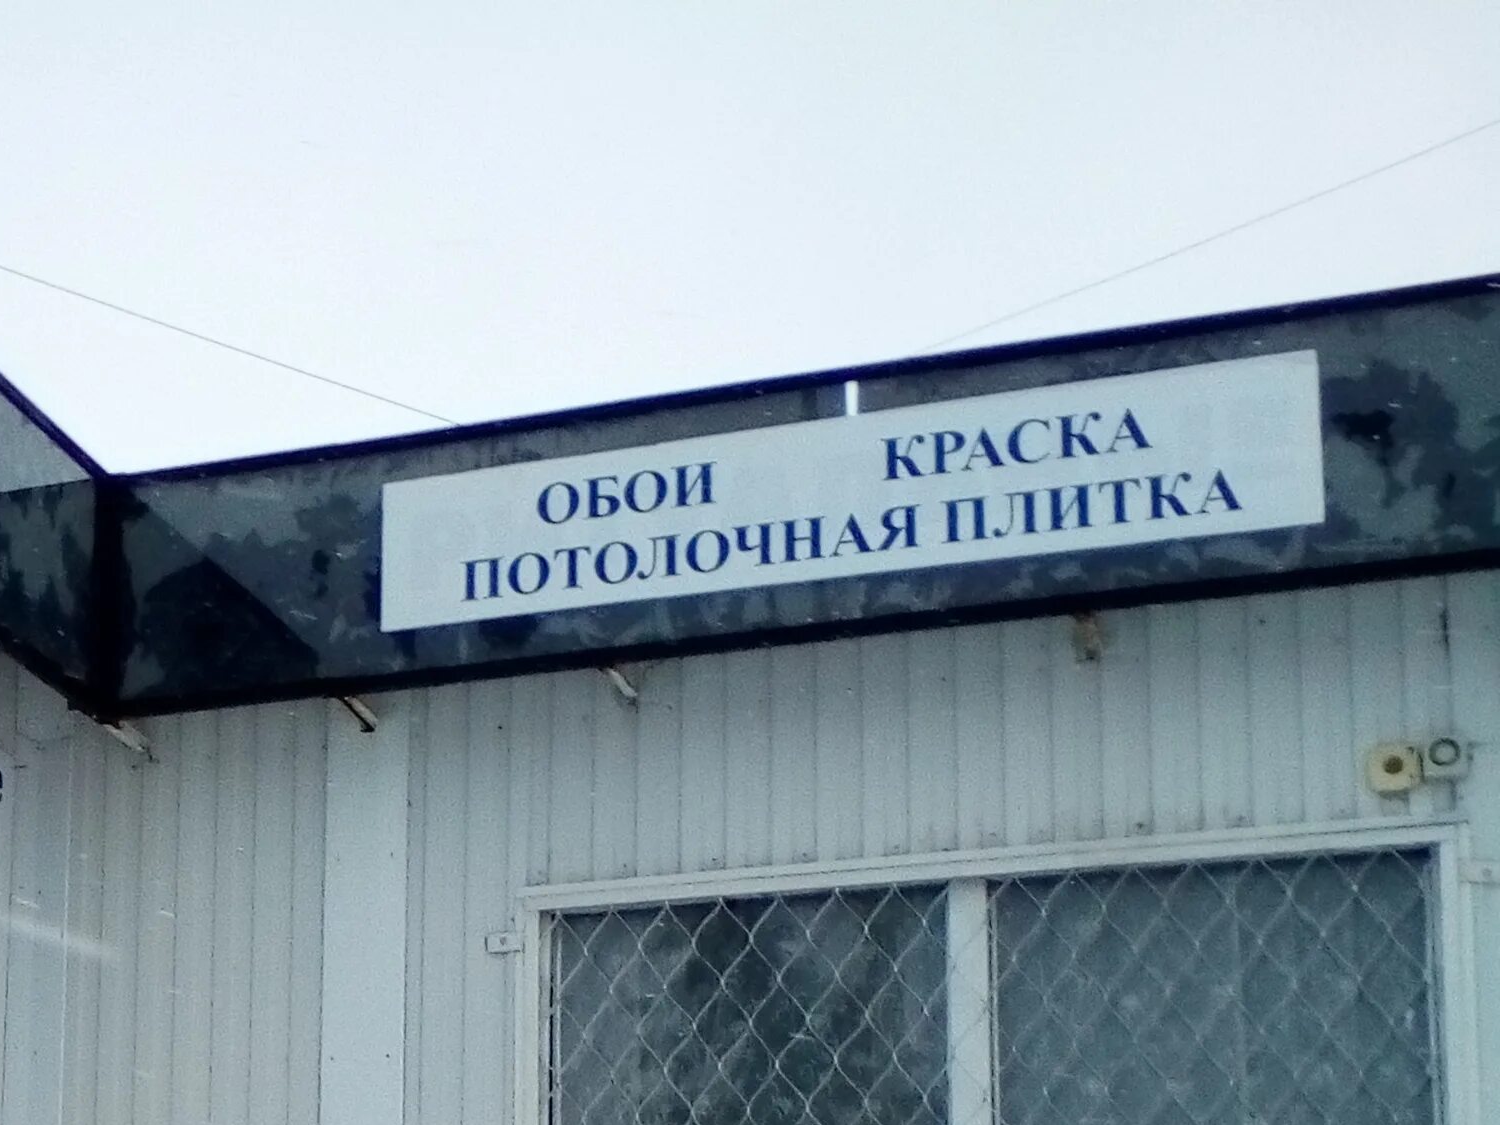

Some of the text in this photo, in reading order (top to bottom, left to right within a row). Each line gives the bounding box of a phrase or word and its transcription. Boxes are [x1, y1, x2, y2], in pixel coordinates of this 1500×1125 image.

[880, 408, 1153, 481] КРАСКА
[537, 461, 717, 526] ОБОИ
[461, 468, 1243, 602] ПОТОЛОЧНАЯ ПЛИТКА
